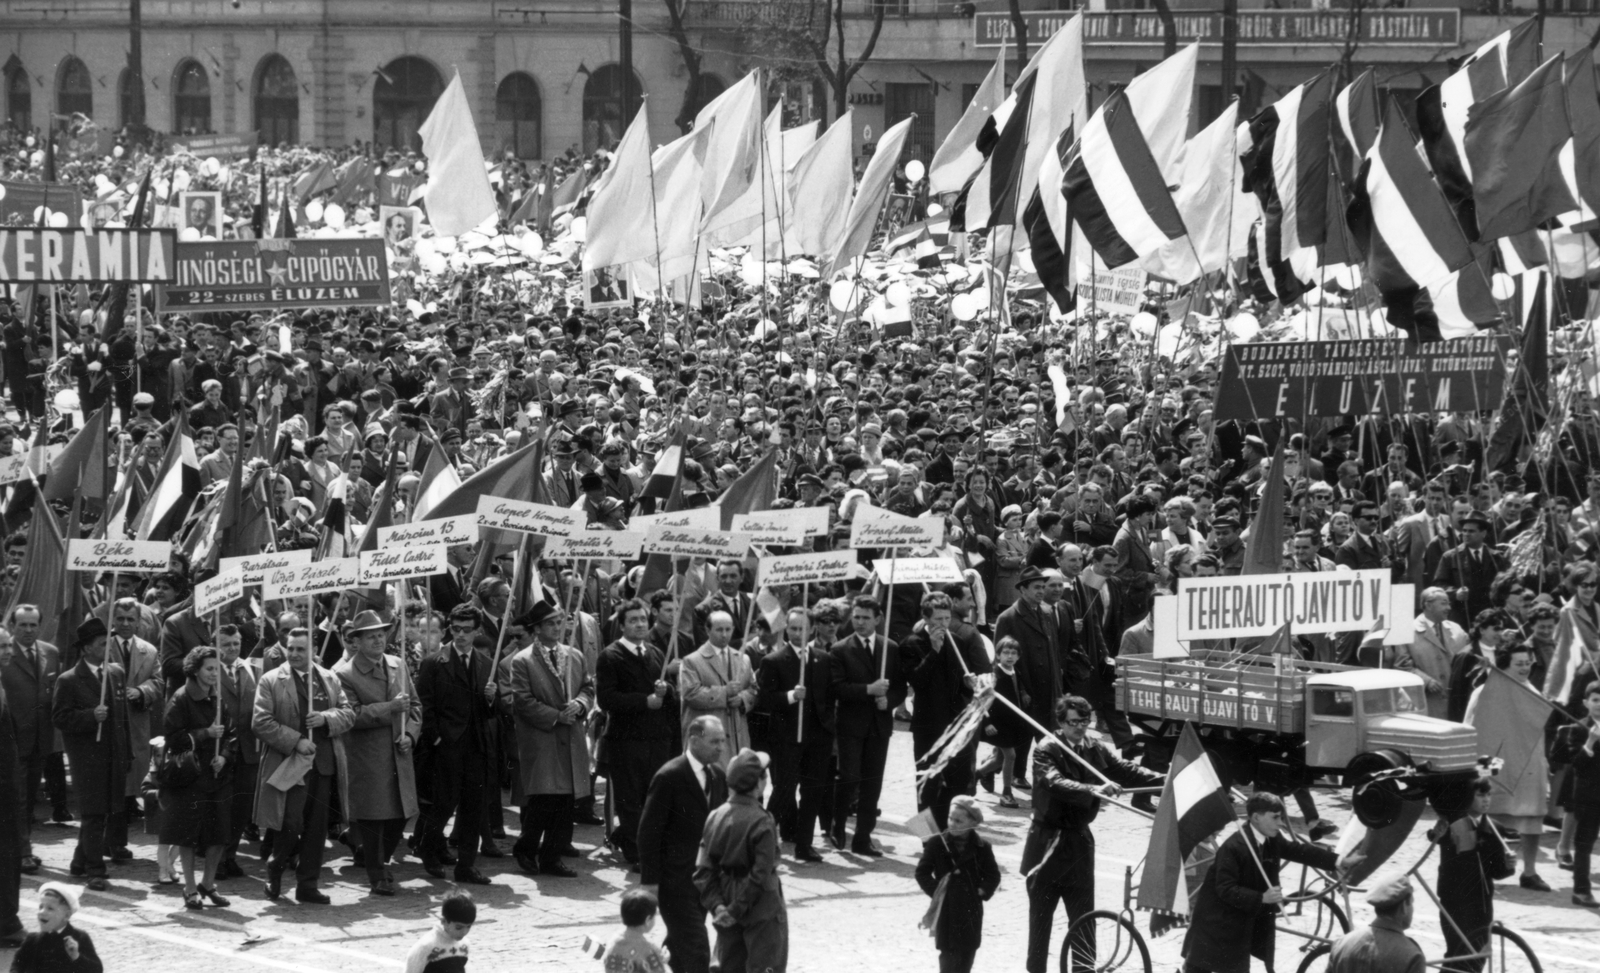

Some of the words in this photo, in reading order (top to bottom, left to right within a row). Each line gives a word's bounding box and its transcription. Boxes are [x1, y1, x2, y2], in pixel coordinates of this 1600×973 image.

[1134, 17, 1211, 38] KOMMNIZMUS
[176, 250, 263, 287] INŐSÉGI
[287, 248, 381, 283] CIPŐGYÁR
[385, 527, 435, 543] Március
[440, 520, 455, 534] 15
[92, 542, 134, 556] Béke
[95, 556, 137, 568] Szocialista
[138, 559, 168, 570] Brigád
[369, 552, 401, 567] Fidel
